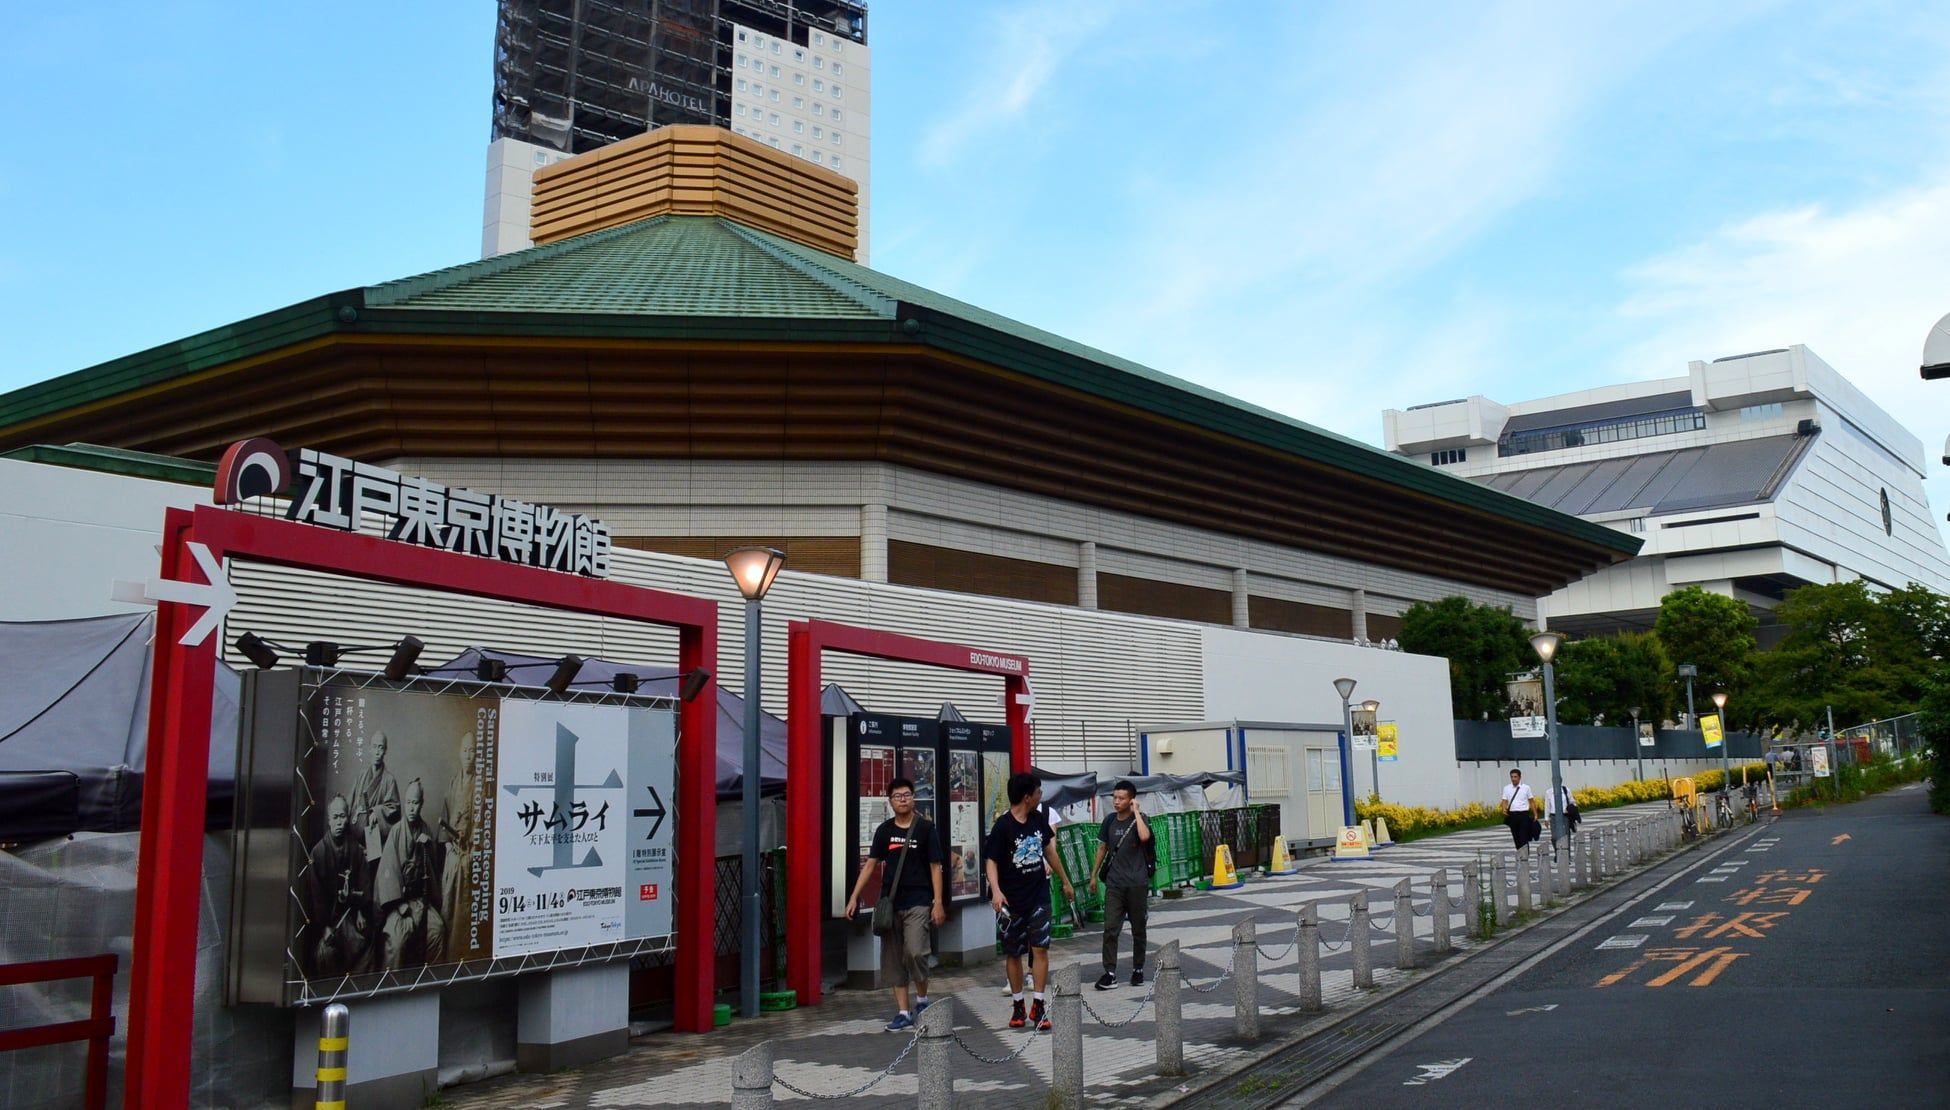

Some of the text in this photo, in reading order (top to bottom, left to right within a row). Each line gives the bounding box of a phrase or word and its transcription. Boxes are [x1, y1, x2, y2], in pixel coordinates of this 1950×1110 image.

[299, 447, 612, 579] 江戸東京博物館
[533, 772, 553, 782] 特別展
[470, 707, 486, 949] Contributors in Edo Period
[517, 800, 609, 837] サムライ
[499, 887, 515, 895] 2019
[499, 895, 526, 914] 9/14
